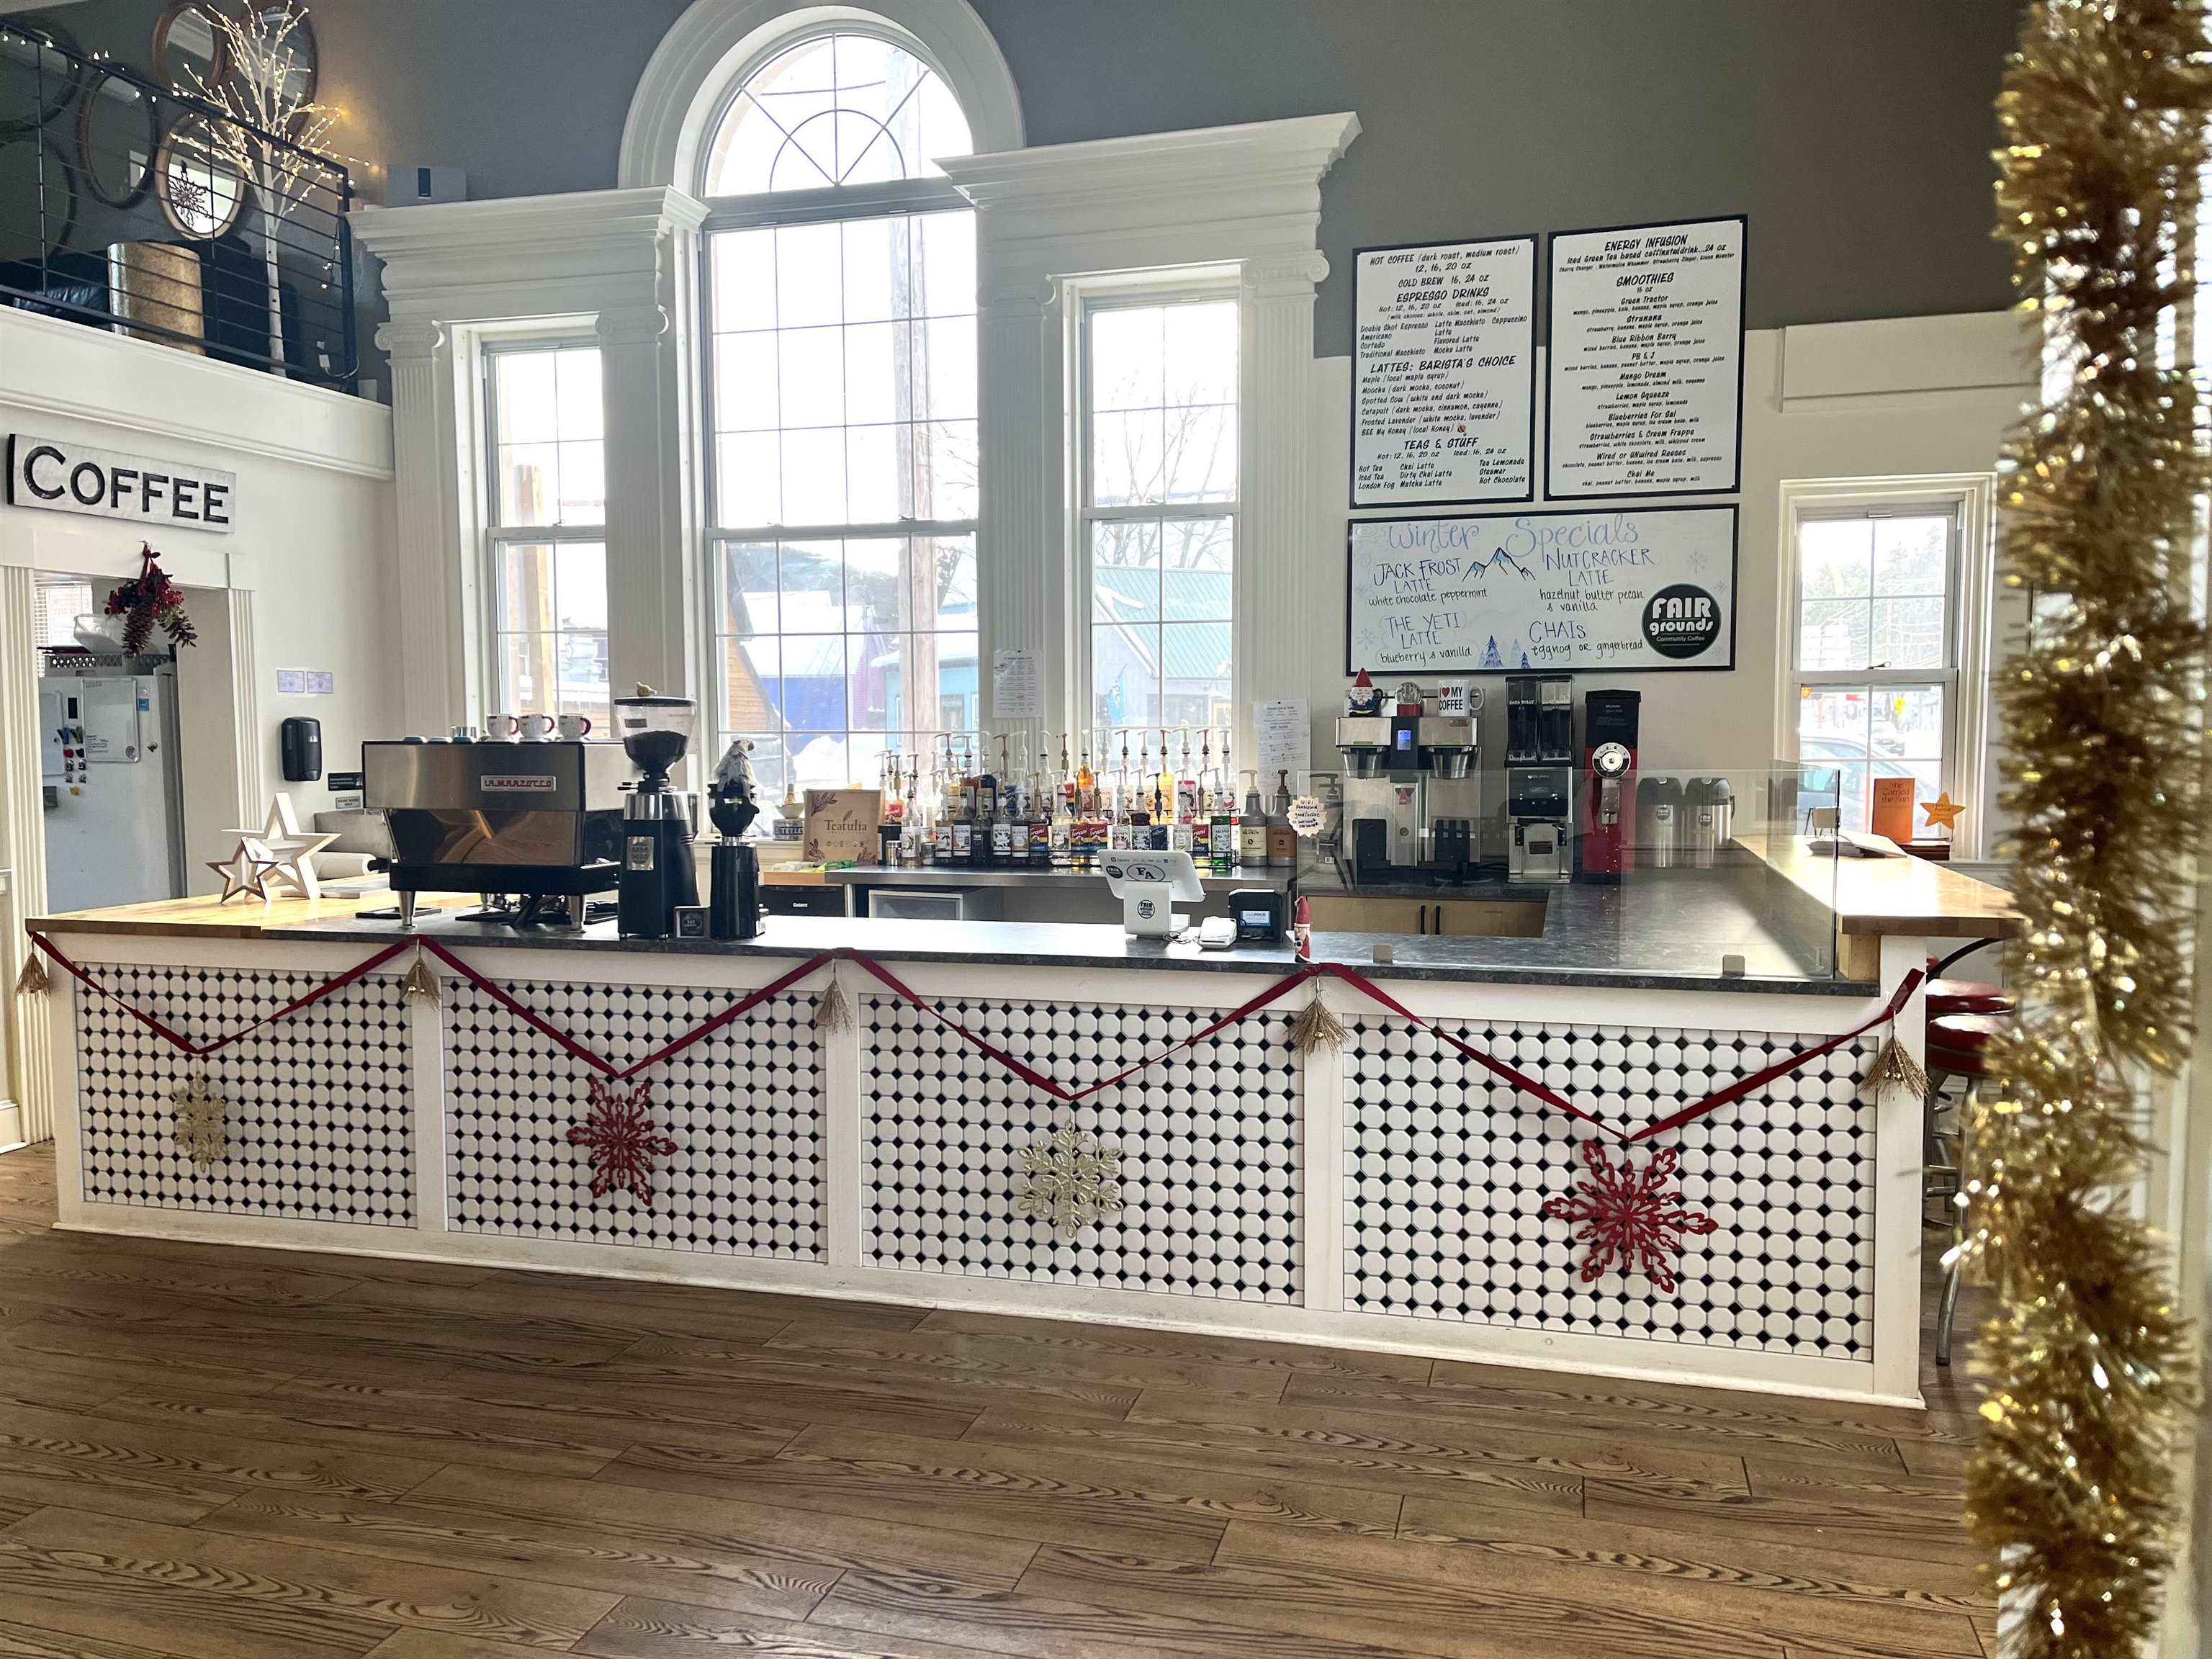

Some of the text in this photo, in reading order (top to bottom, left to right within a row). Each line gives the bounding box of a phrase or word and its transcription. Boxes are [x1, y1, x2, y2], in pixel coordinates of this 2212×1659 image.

[1604, 235, 1688, 251] ENERGY INFUSION
[1370, 256, 1384, 265] HOT
[1388, 253, 1414, 264] COFFEE
[1465, 249, 1492, 258] medium
[1620, 250, 1642, 259] based
[1444, 261, 1457, 271] 20
[1398, 278, 1417, 288] COLD
[1420, 276, 1444, 286] BREW
[1464, 274, 1475, 283] 24
[1617, 272, 1674, 287] SMOOTHIES
[1396, 287, 1489, 302] ESPRESSO DRINKS
[1643, 295, 1668, 303] Tractor
[1455, 318, 1485, 326] Macchiato
[1491, 315, 1527, 324] Cappuccino
[1400, 322, 1428, 331] Espresso
[1360, 341, 1385, 349] Cortado
[1611, 335, 1627, 343] Blue
[1478, 355, 1516, 367] CHOICE
[1362, 375, 1380, 384] Maple
[1362, 397, 1388, 405] Spotted
[1640, 391, 1669, 400] Squeeze
[1361, 407, 1388, 415] Catapult
[1608, 412, 1647, 421] Blueberries
[1590, 431, 1635, 440] Strawberries
[1404, 437, 1478, 449] TEAS & STUFF
[24, 446, 229, 523] COFFEE
[1389, 513, 1640, 563] Winter Specials
[1546, 547, 1655, 571] NUTCRACKER
[1374, 558, 1461, 586] JACK FROST
[1568, 569, 1614, 587] LATTE
[1394, 578, 1435, 594] LATTE
[1368, 588, 1488, 606] white chocolate peppermint
[1584, 588, 1614, 601] butter
[1618, 590, 1644, 604] pecan
[1560, 602, 1599, 611] vanilla
[1652, 597, 1712, 619] FAIR
[1385, 613, 1461, 638] THE YETI
[1649, 618, 1714, 636] grounds
[1401, 631, 1442, 649] LATTE
[1531, 644, 1572, 661] eggnog
[1596, 639, 1643, 660] gingerbread
[1380, 652, 1426, 667] blueberry
[1439, 646, 1472, 658] vanilla
[1451, 686, 1463, 698] MY
[1439, 699, 1463, 711] COFFEE
[823, 819, 868, 831] Teatulia
